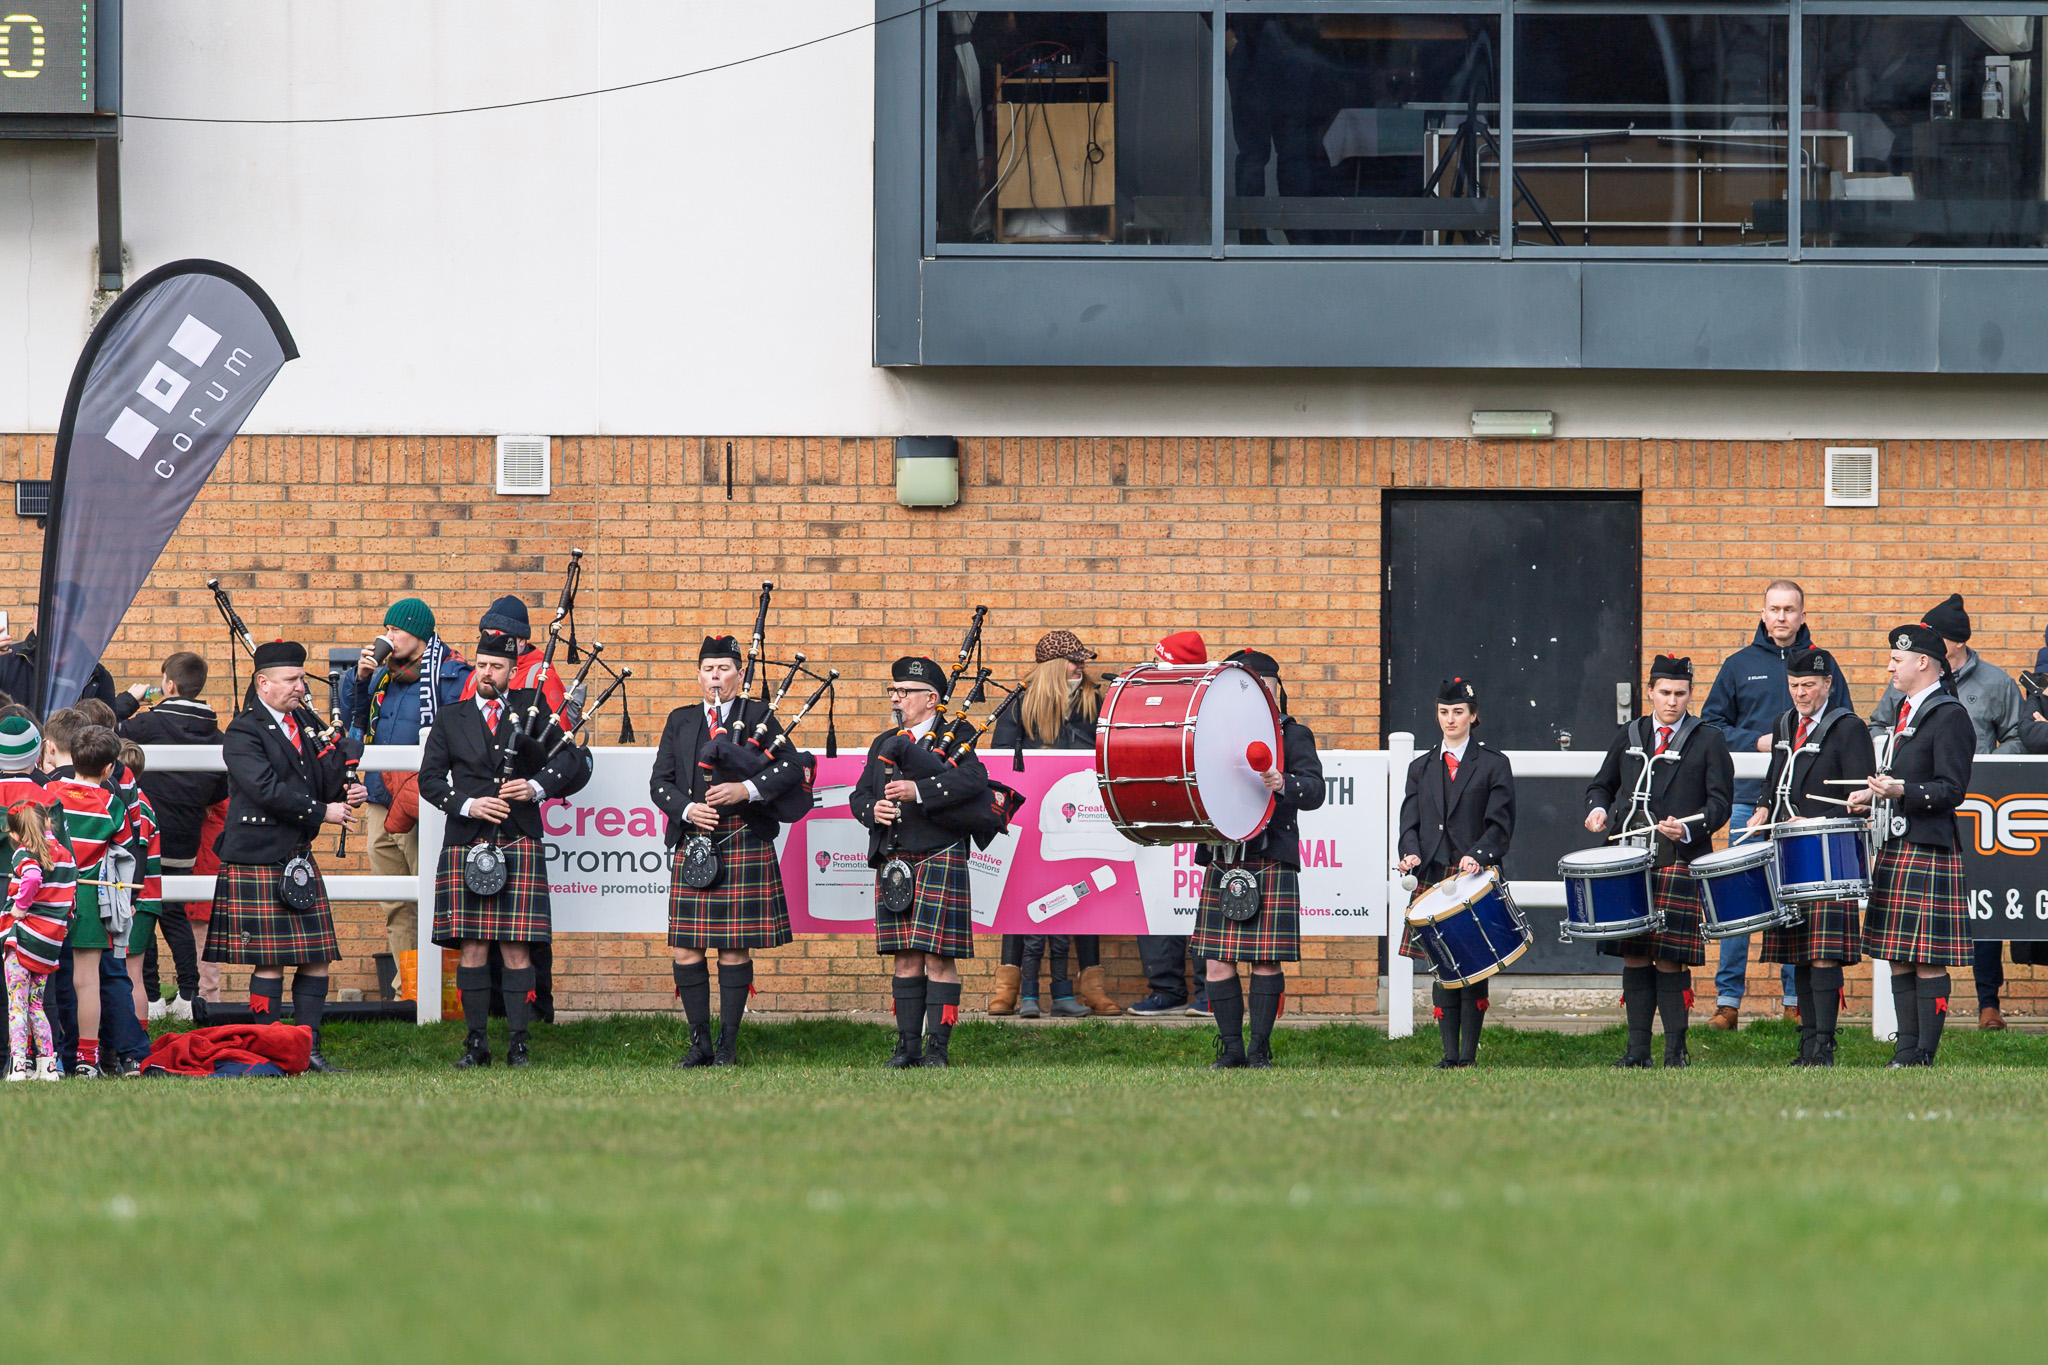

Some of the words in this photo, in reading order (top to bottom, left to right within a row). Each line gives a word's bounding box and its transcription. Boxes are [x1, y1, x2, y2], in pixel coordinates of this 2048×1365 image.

[154, 347, 253, 479] corum
[540, 798, 669, 837] Crea
[970, 851, 1002, 866] eative
[2005, 888, 2024, 920] &
